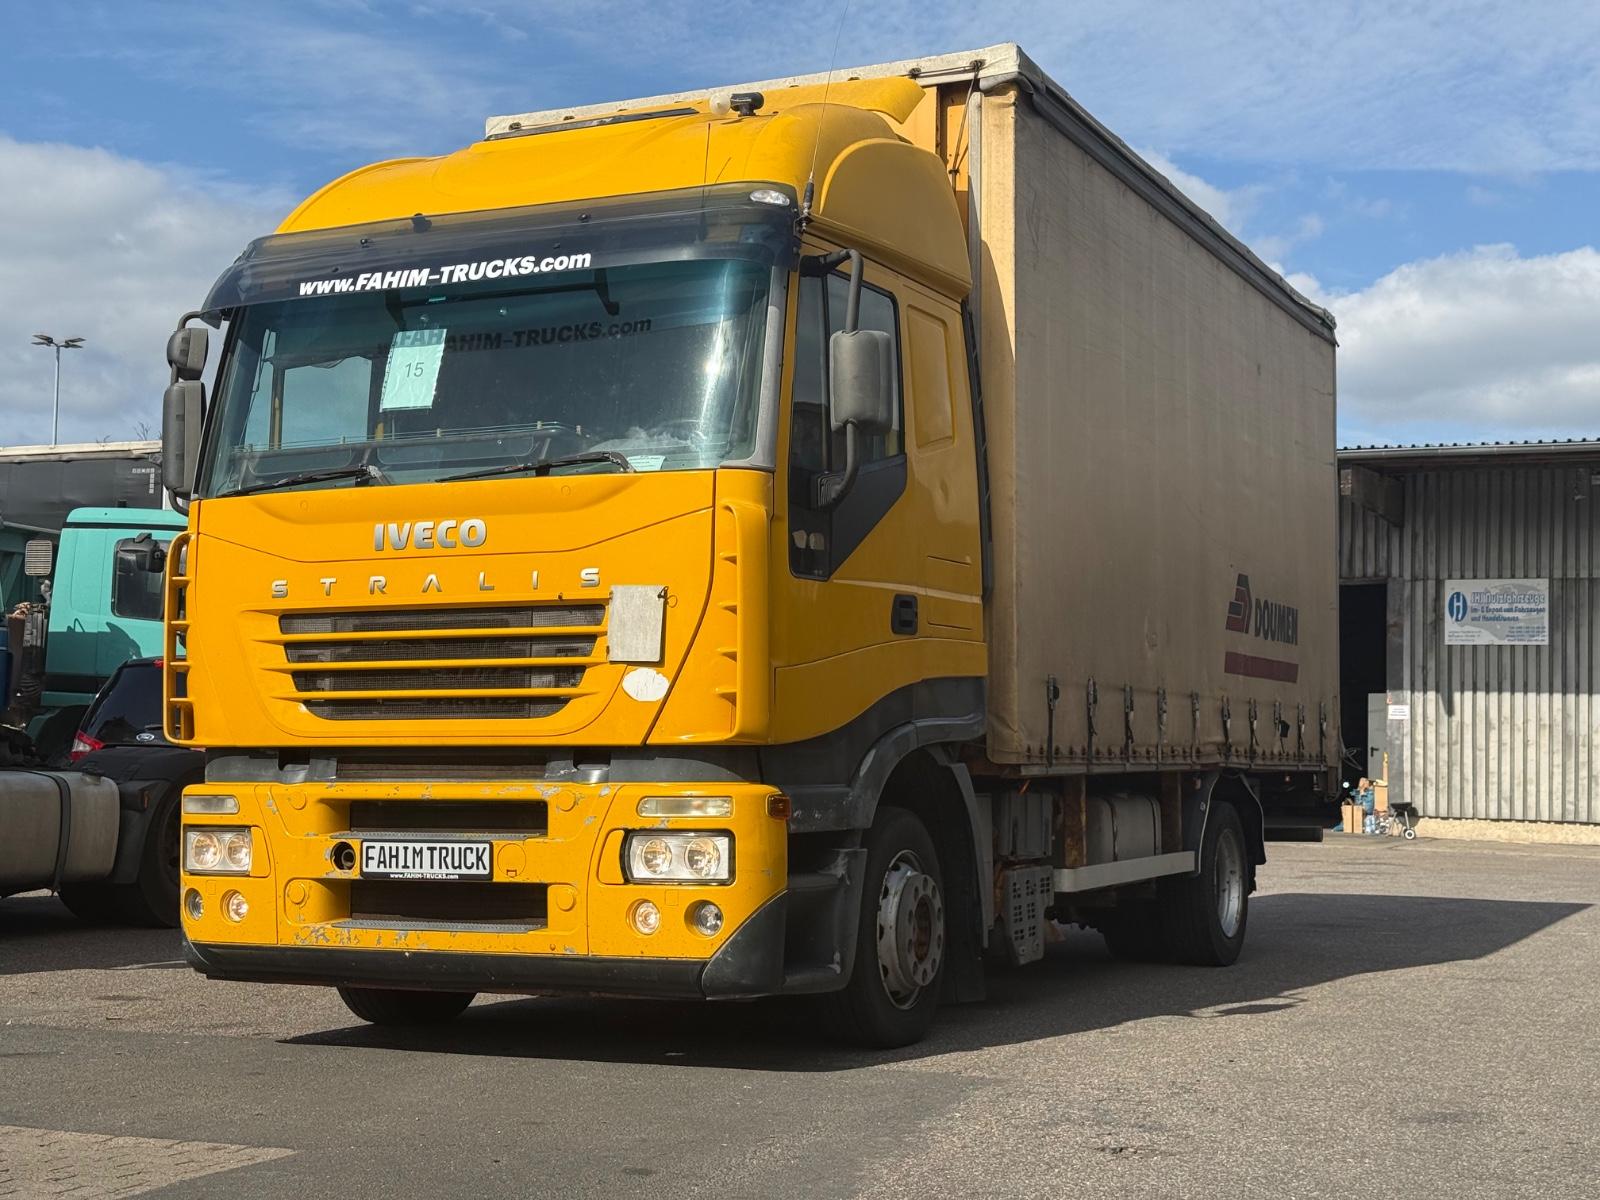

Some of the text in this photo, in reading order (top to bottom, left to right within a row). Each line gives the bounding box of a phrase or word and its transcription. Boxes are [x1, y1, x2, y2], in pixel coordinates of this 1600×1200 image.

[299, 253, 592, 296] www.FAHIM-TRUCKS.com
[405, 361, 425, 378] 15
[373, 518, 488, 552] IVECO
[271, 567, 601, 599] STRALIS
